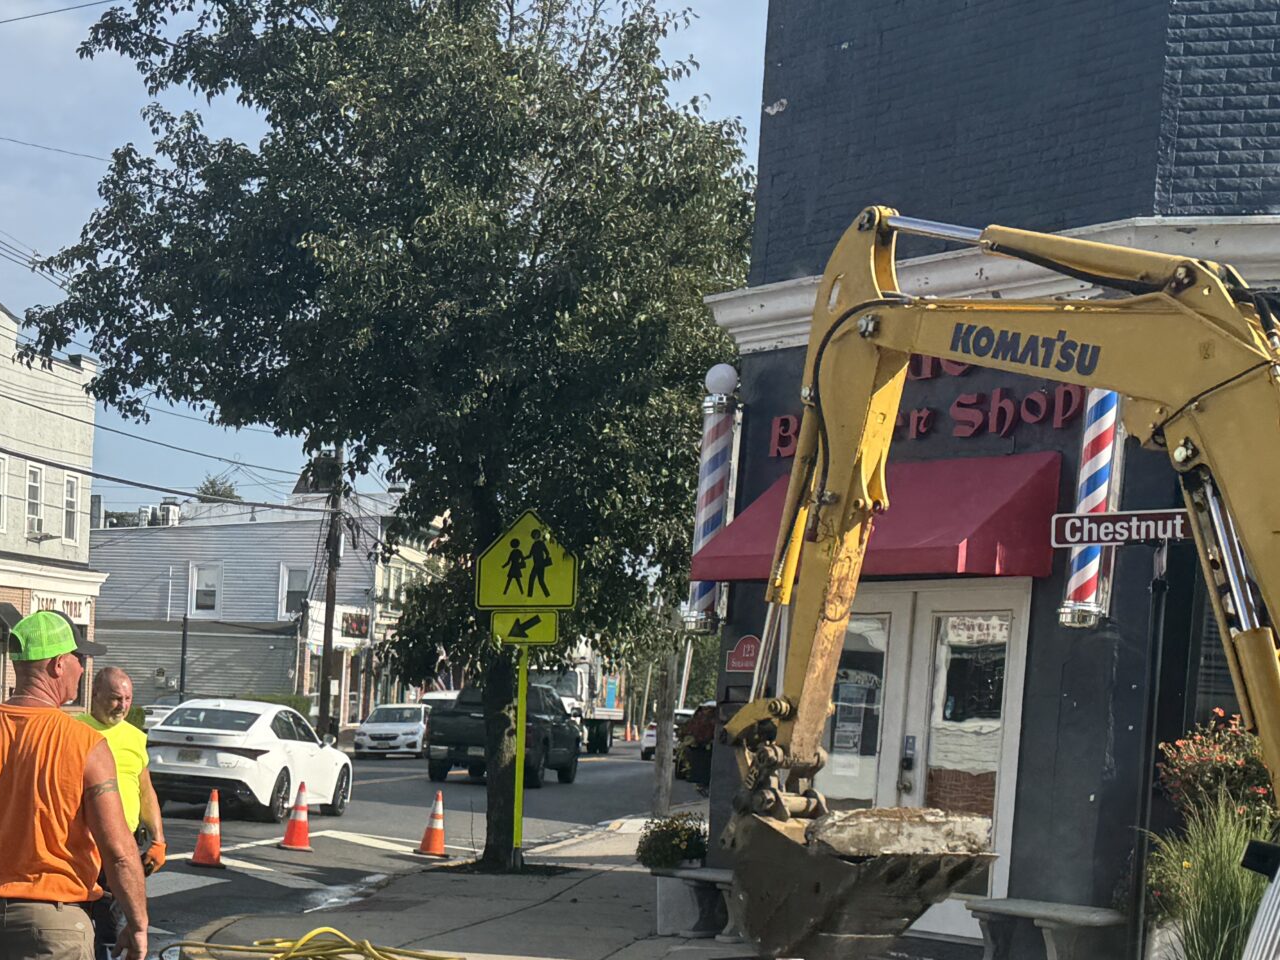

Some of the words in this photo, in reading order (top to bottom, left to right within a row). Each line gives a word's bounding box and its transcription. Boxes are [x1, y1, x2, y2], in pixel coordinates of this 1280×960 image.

[949, 321, 1101, 376] KOMATSU
[949, 383, 1086, 438] Shop
[1064, 514, 1185, 543] Chestnut
